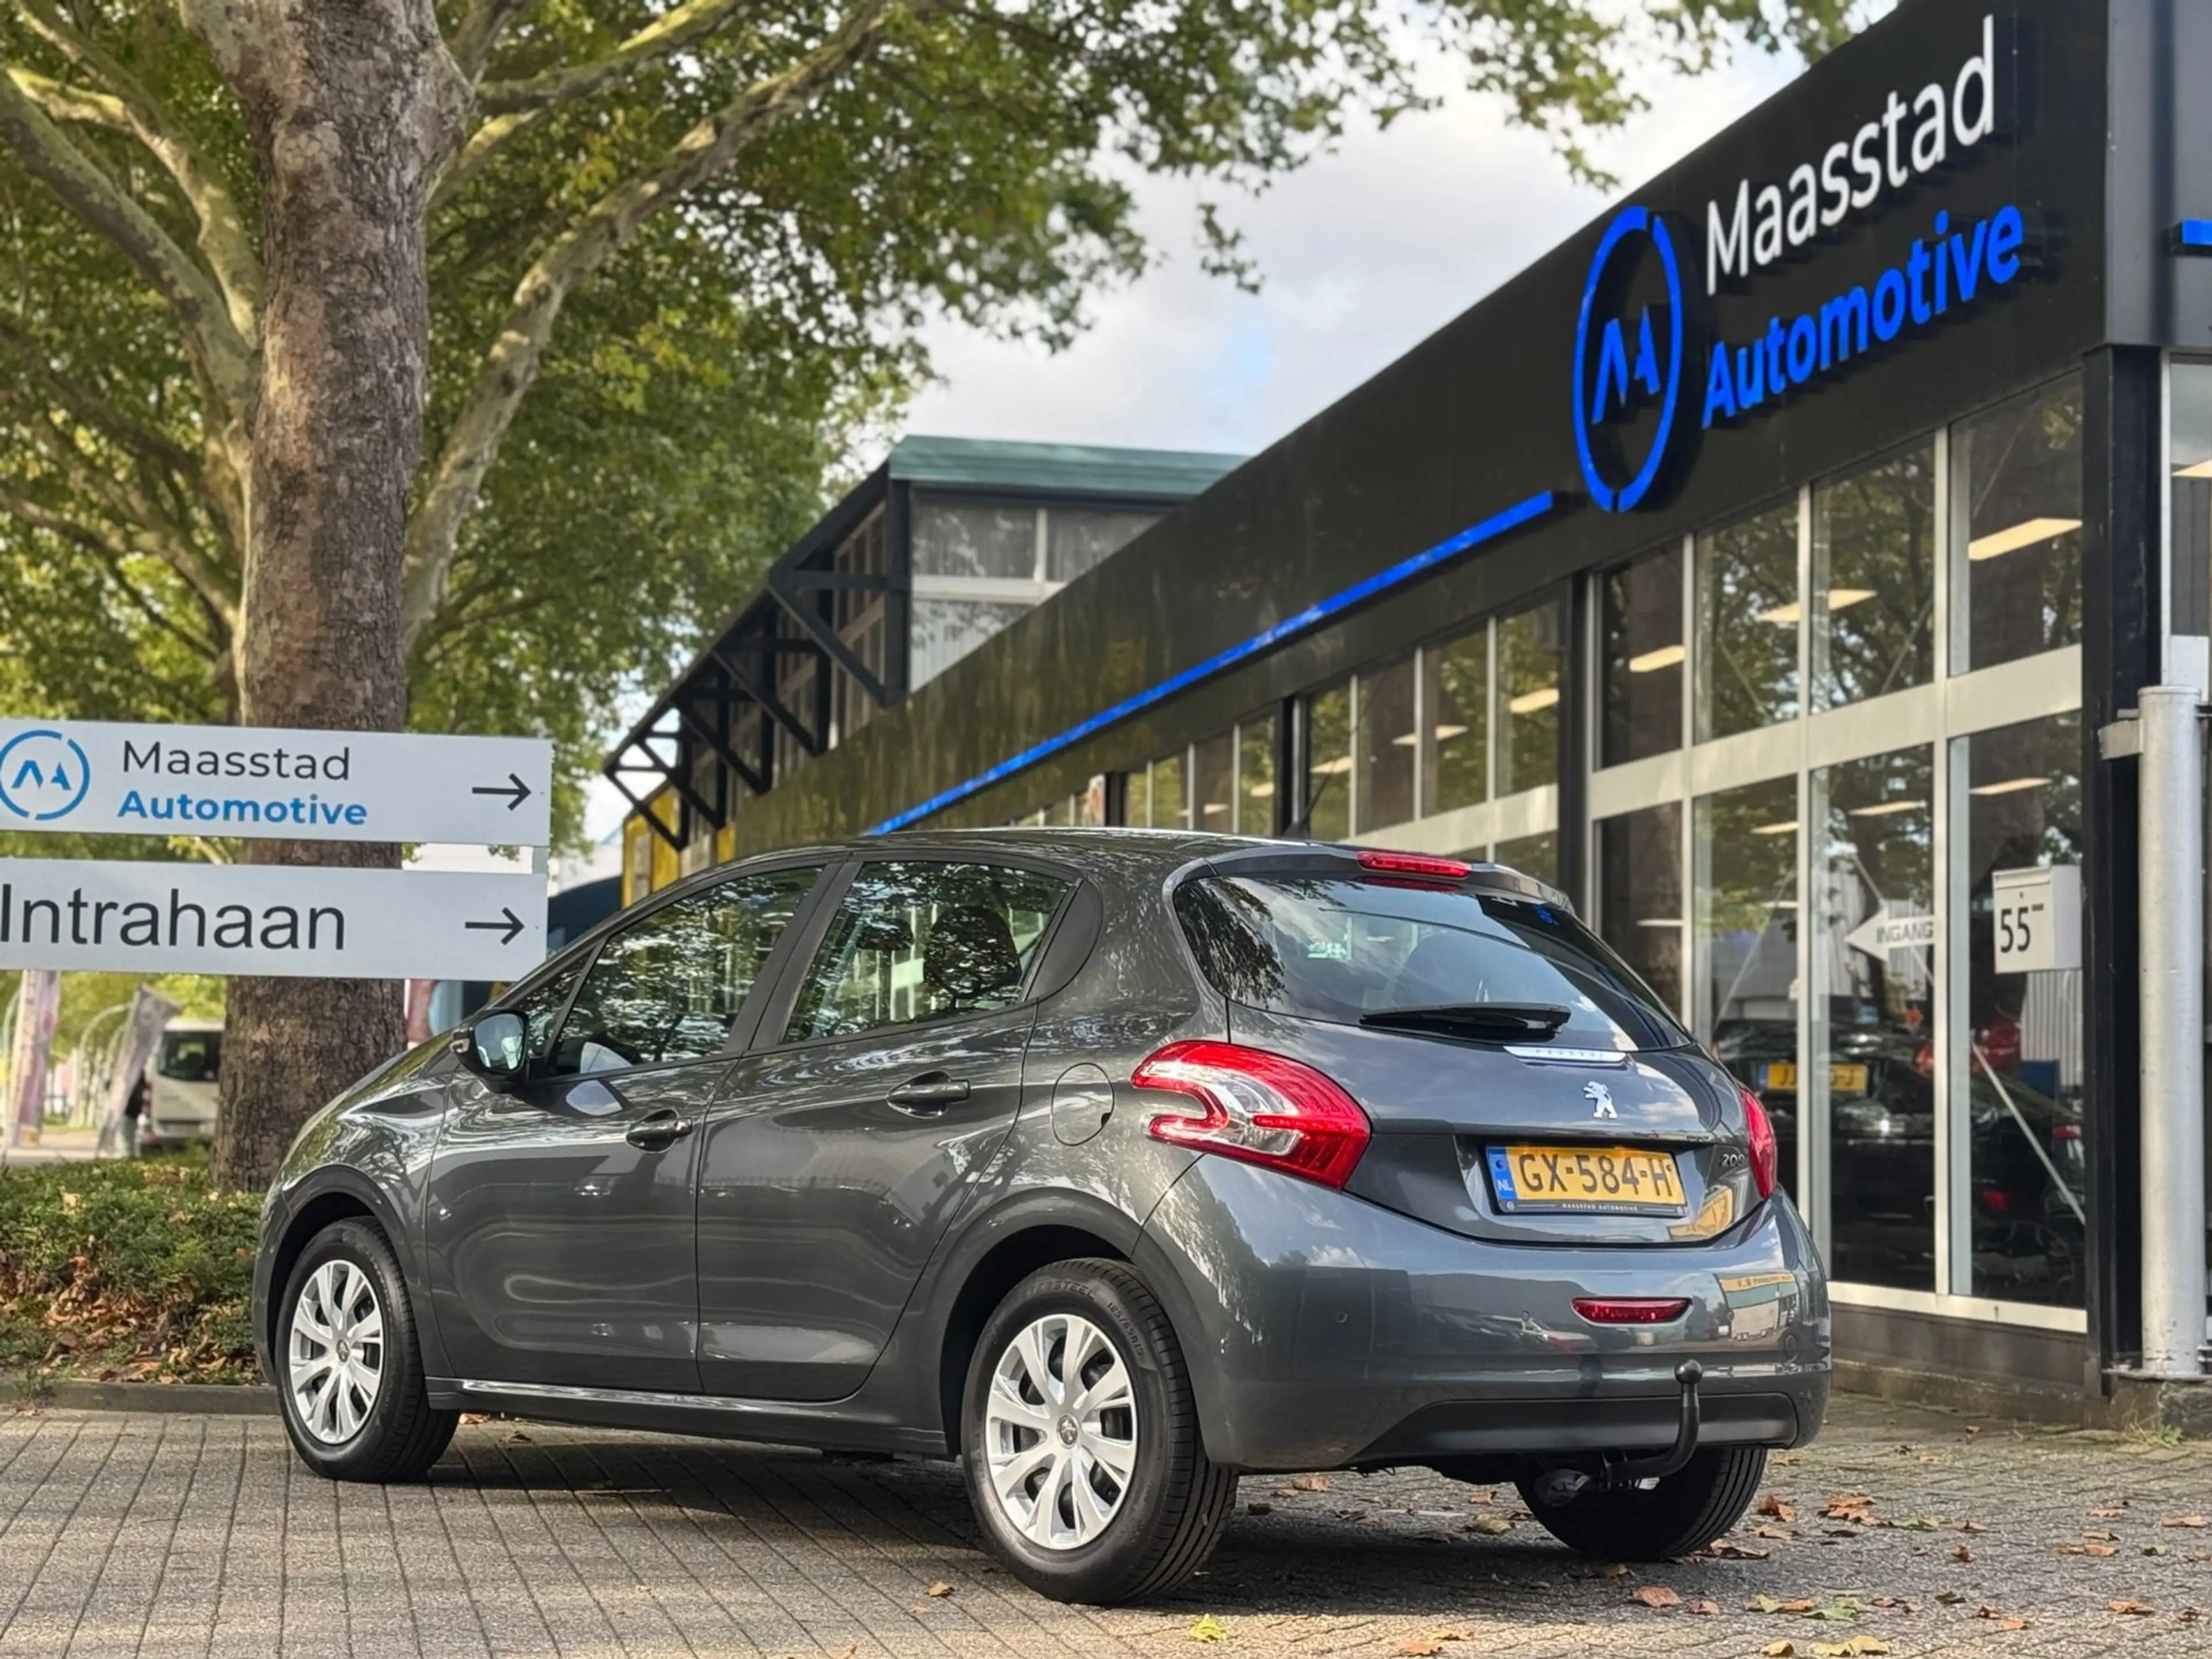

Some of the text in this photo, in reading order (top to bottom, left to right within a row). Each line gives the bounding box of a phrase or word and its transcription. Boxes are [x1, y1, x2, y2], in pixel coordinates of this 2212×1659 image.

[1707, 14, 1994, 296] Maasstad
[1702, 204, 2025, 428] Automotive
[123, 740, 350, 781] Maasstad
[118, 790, 368, 826] Automotive
[1, 883, 344, 950] Intrahaan
[1876, 922, 1933, 944] INGANG
[2000, 906, 2031, 953] 55
[1497, 1179, 1513, 1191] NL
[1518, 1153, 1673, 1197] GX-584-H
